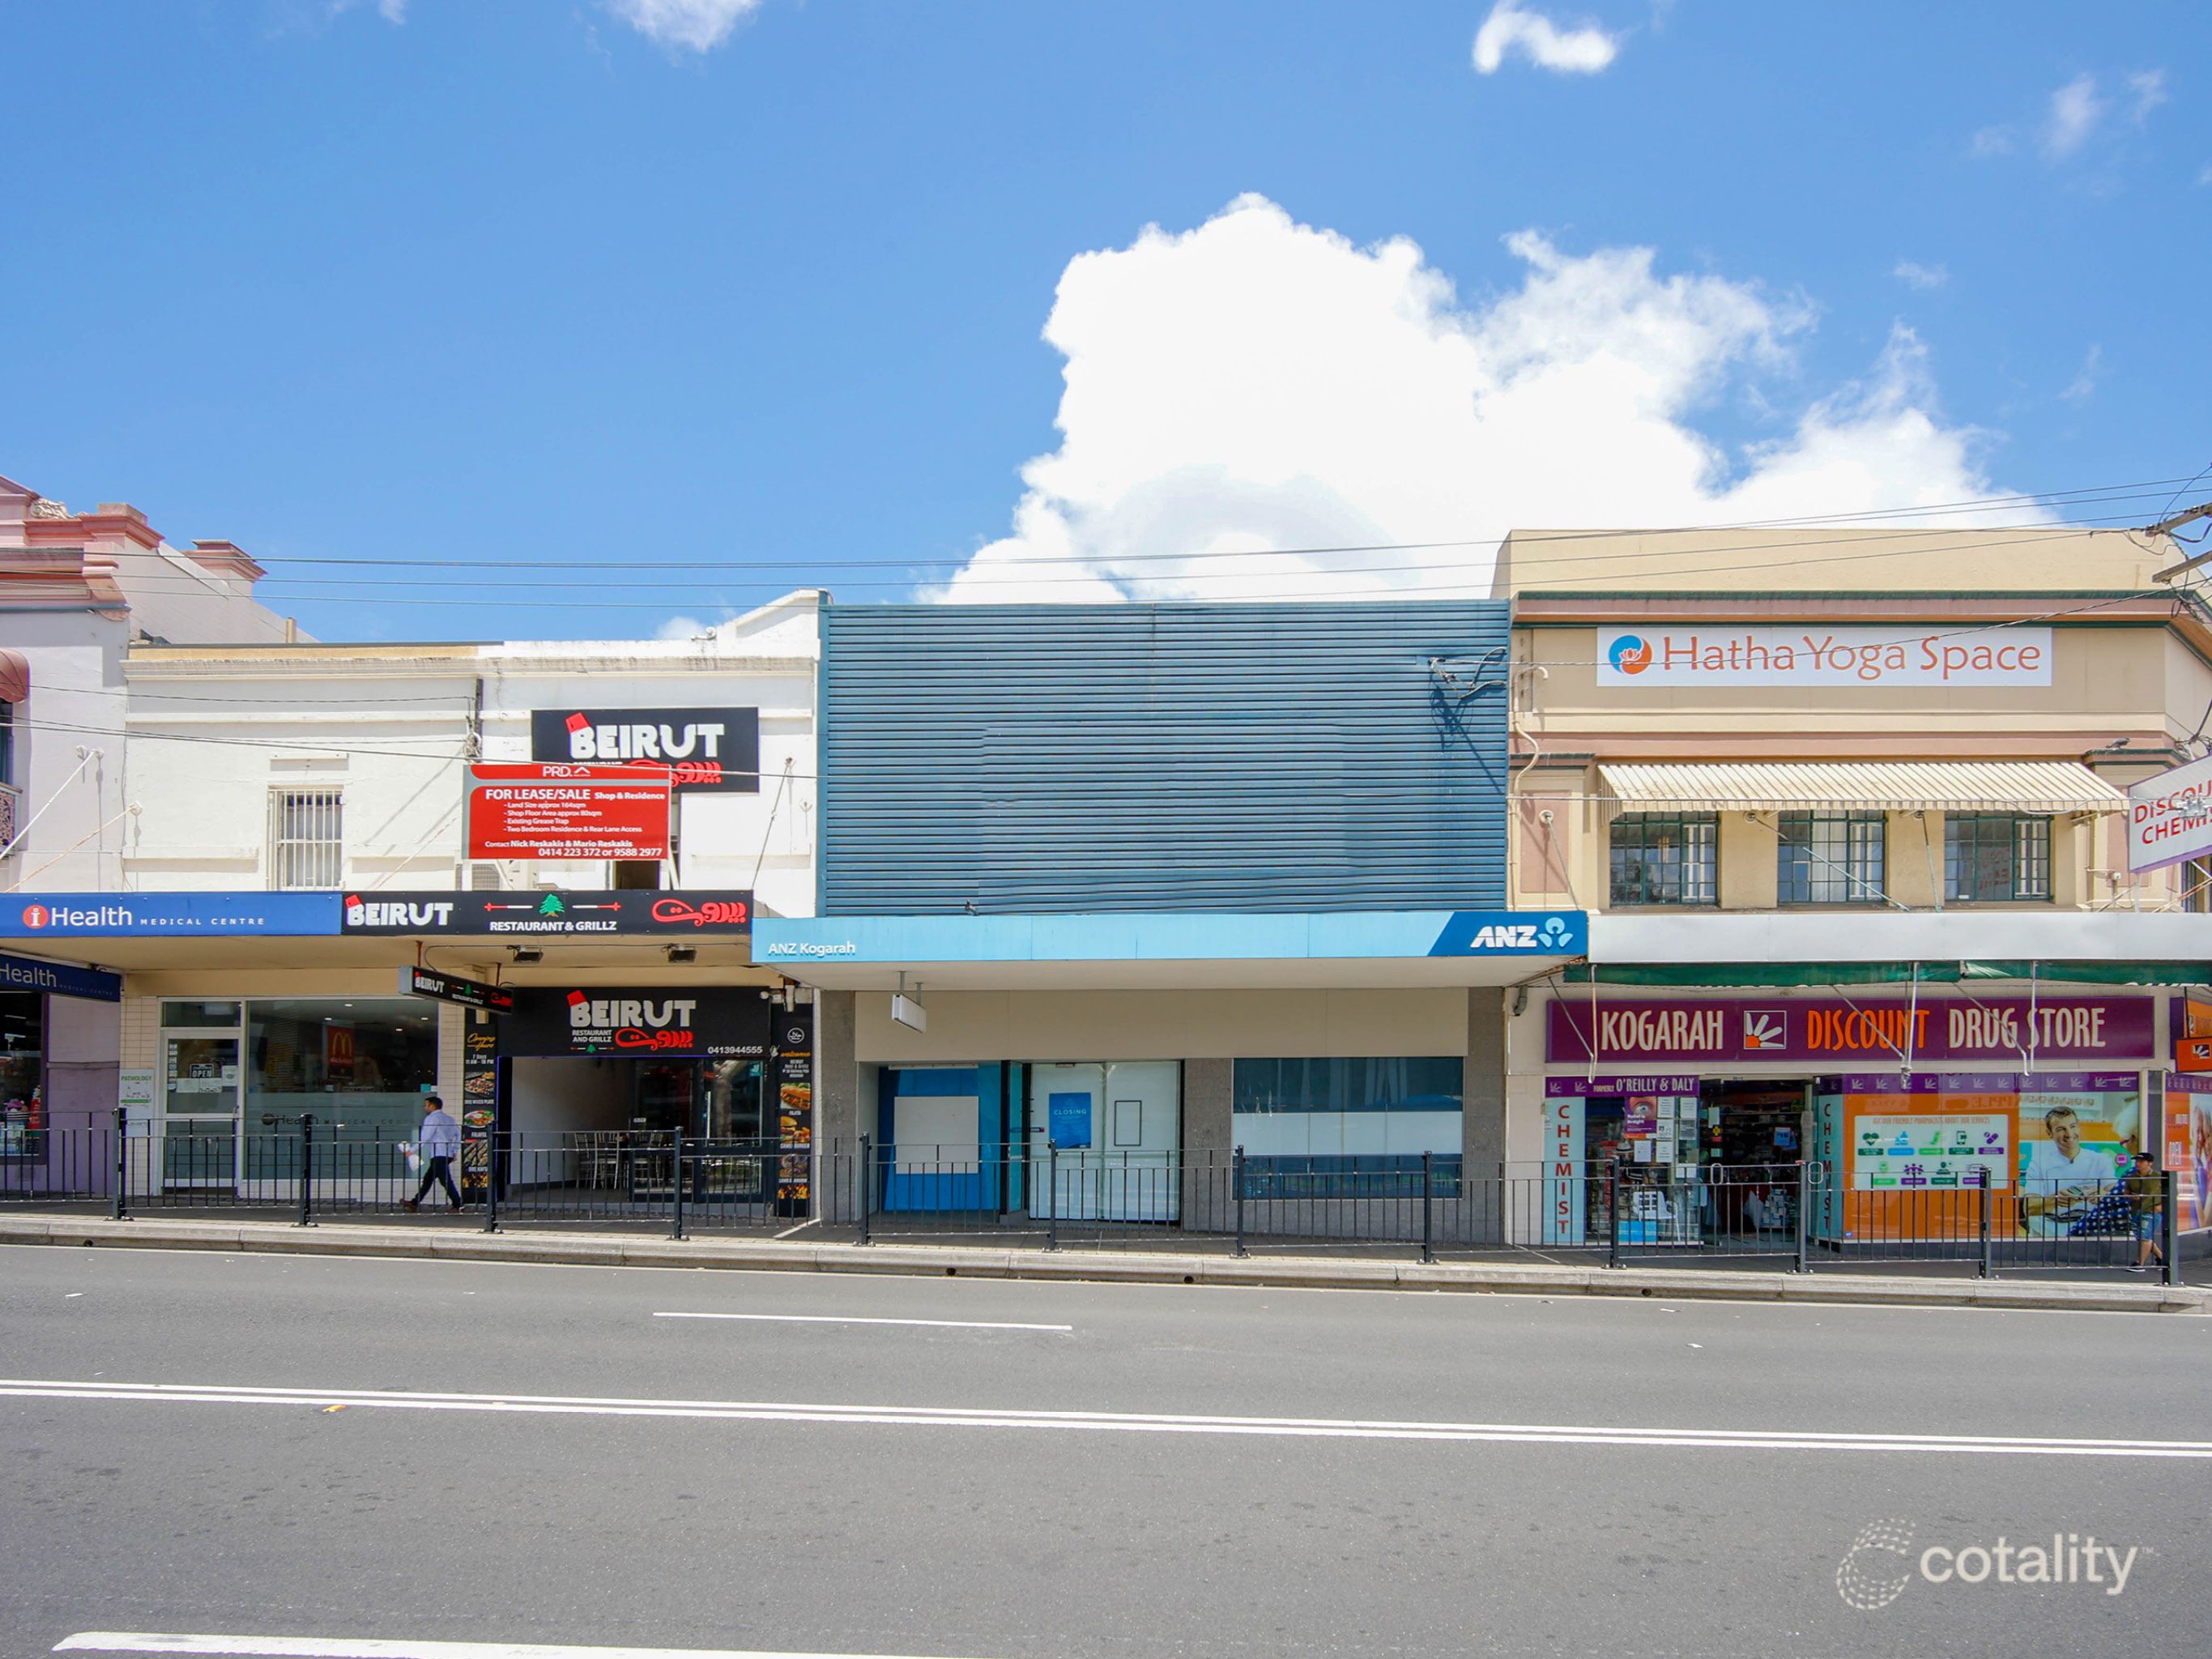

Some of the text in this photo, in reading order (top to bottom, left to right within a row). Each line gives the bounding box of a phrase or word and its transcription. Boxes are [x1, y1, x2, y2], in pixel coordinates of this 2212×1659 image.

[1663, 636, 2041, 681] Hatha Yoga Space
[570, 723, 725, 759] BEIRUT
[485, 789, 512, 800] FOR
[514, 789, 590, 800] LEASE/SALE
[595, 792, 615, 800] Shop
[624, 792, 666, 800] Residence
[564, 848, 582, 856] 223
[583, 848, 601, 856] 372
[613, 848, 637, 856] 9588
[638, 848, 662, 856] 2977
[51, 906, 133, 927] Health
[347, 902, 454, 926] BEIRUT
[489, 921, 618, 932] RESTAURANT & GRILLZ
[1470, 925, 1537, 948] ANZ
[768, 940, 856, 957] ANZ Kogarah
[415, 976, 445, 993] BEIRUT
[570, 1000, 697, 1027] BEIRUT
[1601, 1010, 1724, 1050] KOGARAH
[1807, 1007, 2106, 1051] DISCOUNT DRUG STORE
[707, 1046, 763, 1054] 0413944555
[192, 1068, 212, 1078] OPEN
[1616, 1078, 1657, 1092] O'REILLY
[1660, 1078, 1669, 1092] &
[1672, 1078, 1694, 1092] DALY
[1555, 1104, 1571, 1234] CHEMIST
